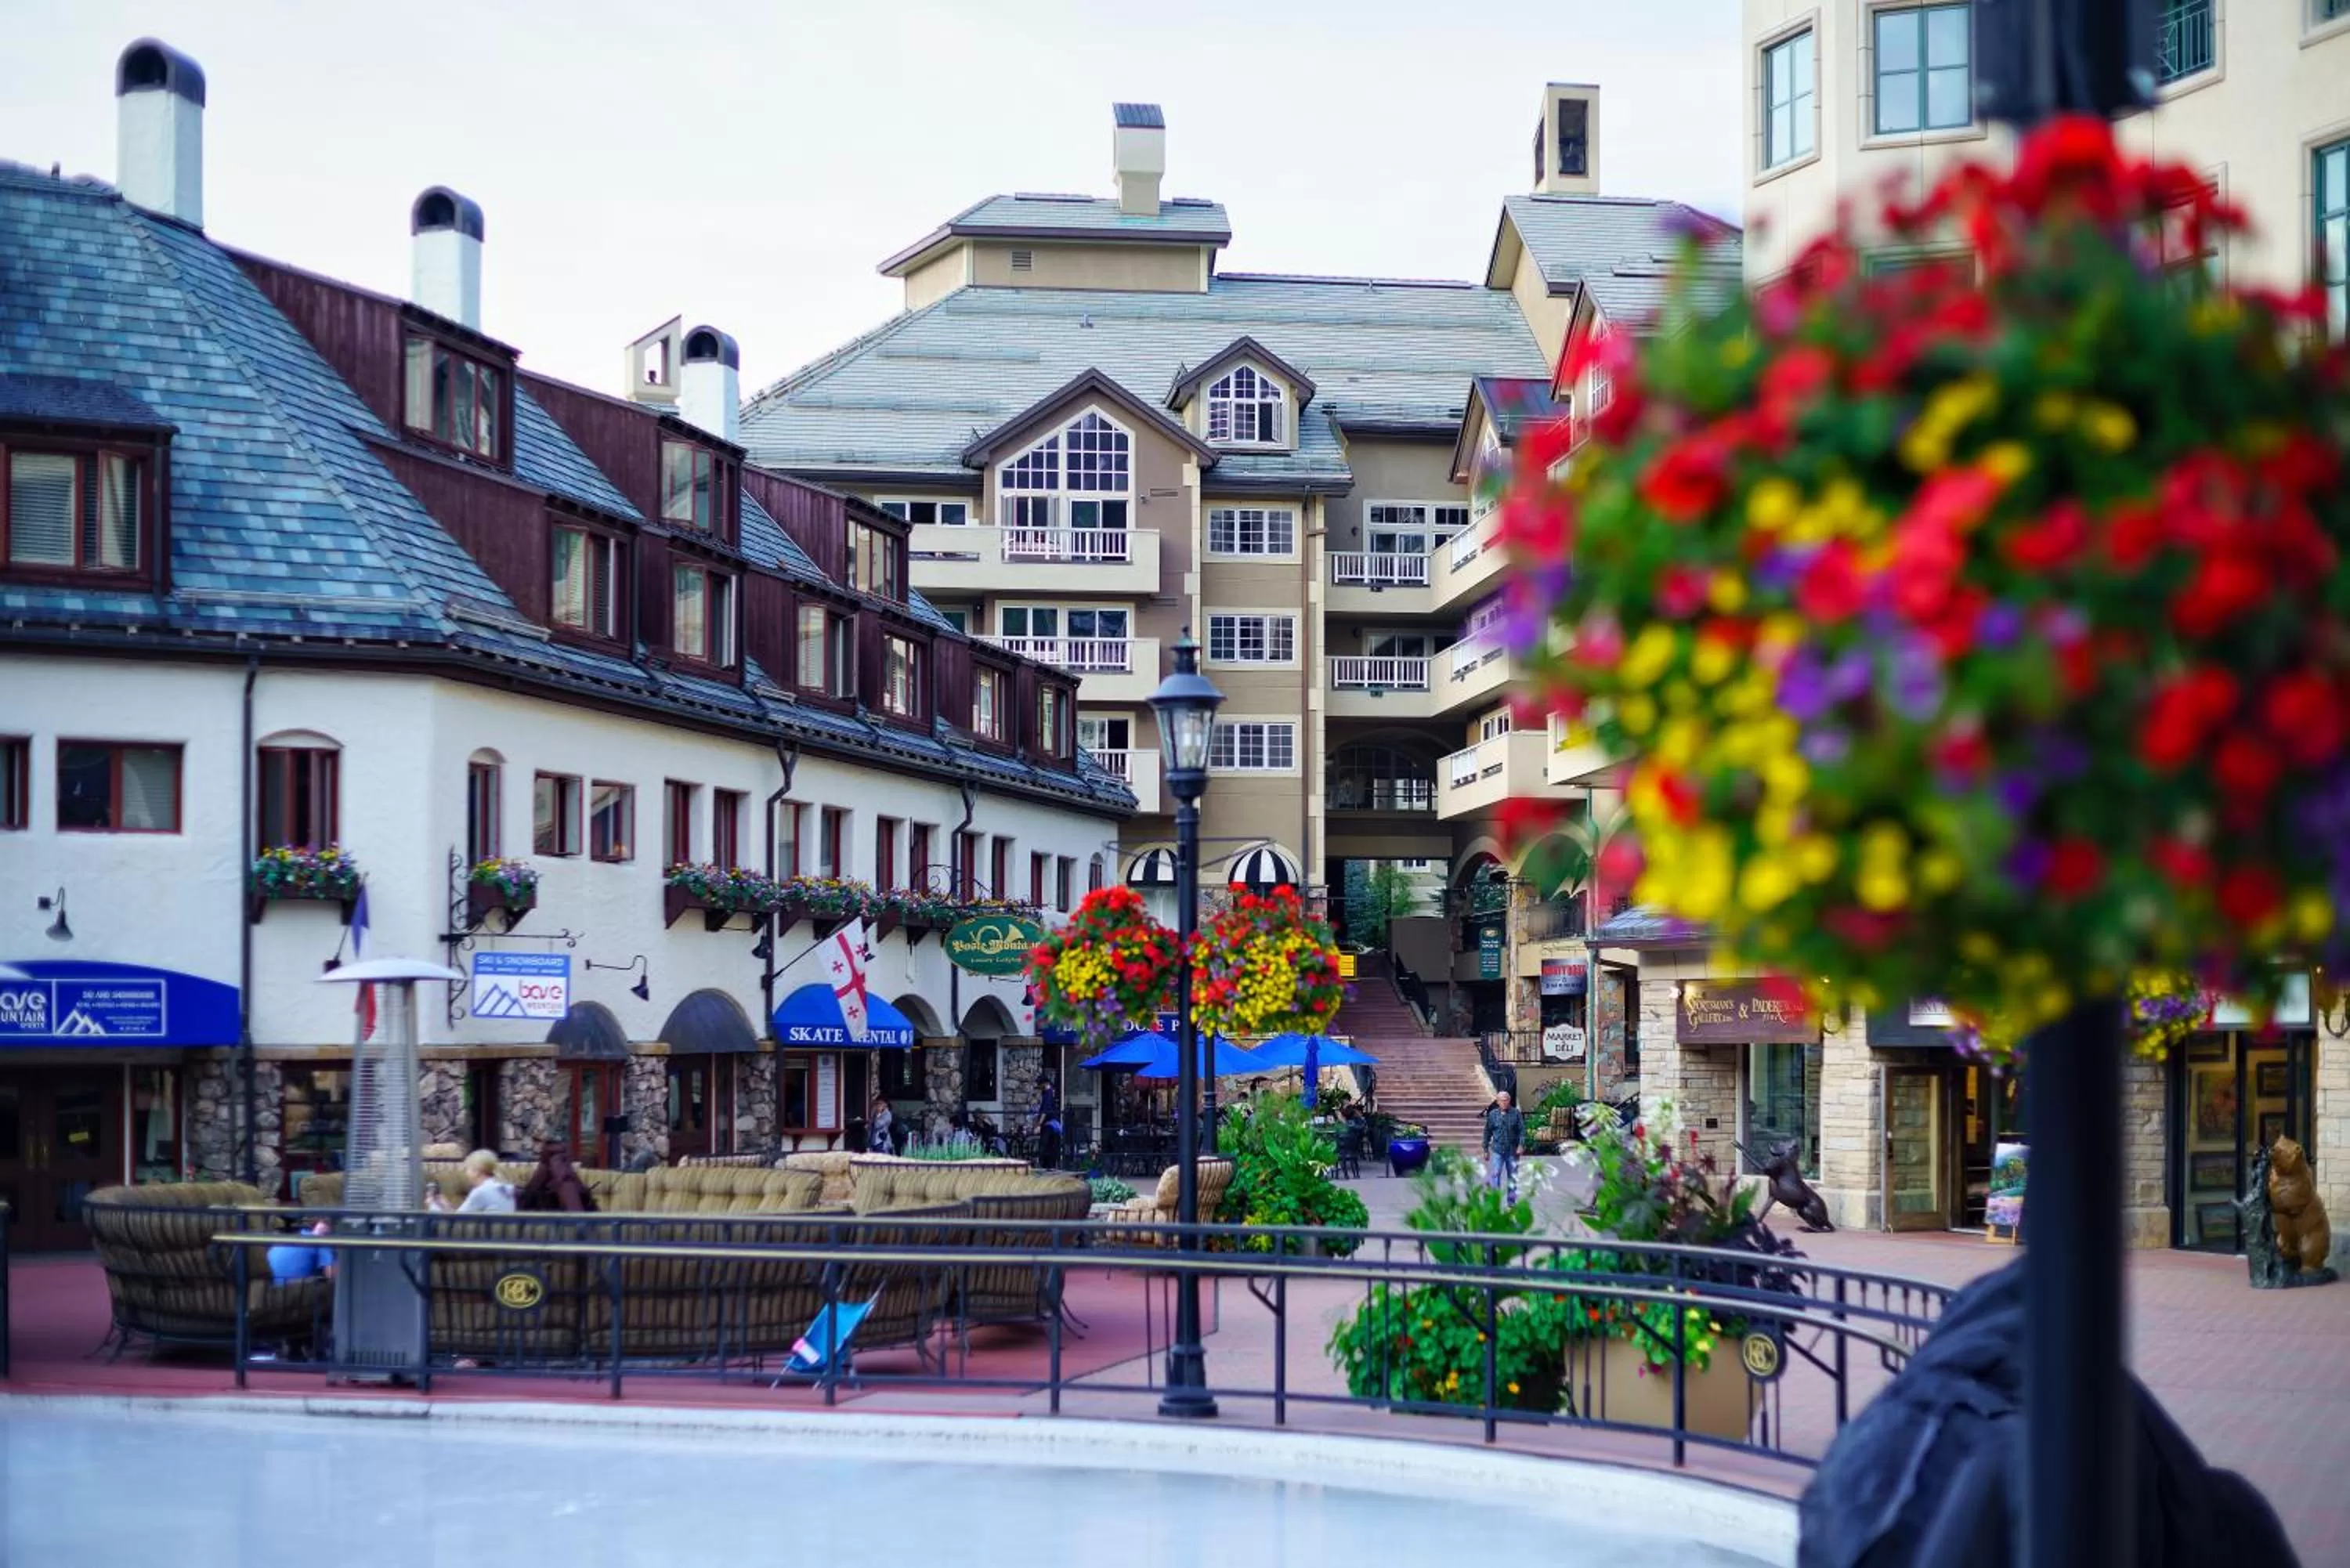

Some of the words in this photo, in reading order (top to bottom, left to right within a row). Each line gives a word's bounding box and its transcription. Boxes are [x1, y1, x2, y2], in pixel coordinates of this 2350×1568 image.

[476, 956, 492, 964] SKI
[504, 956, 565, 966] SNOWBOARD
[0, 992, 47, 1010] ase
[1, 1010, 45, 1022] UNTAIN
[1738, 1003, 1749, 1018] &
[789, 1026, 844, 1042] SKATE
[860, 1029, 897, 1044] ENTAL
